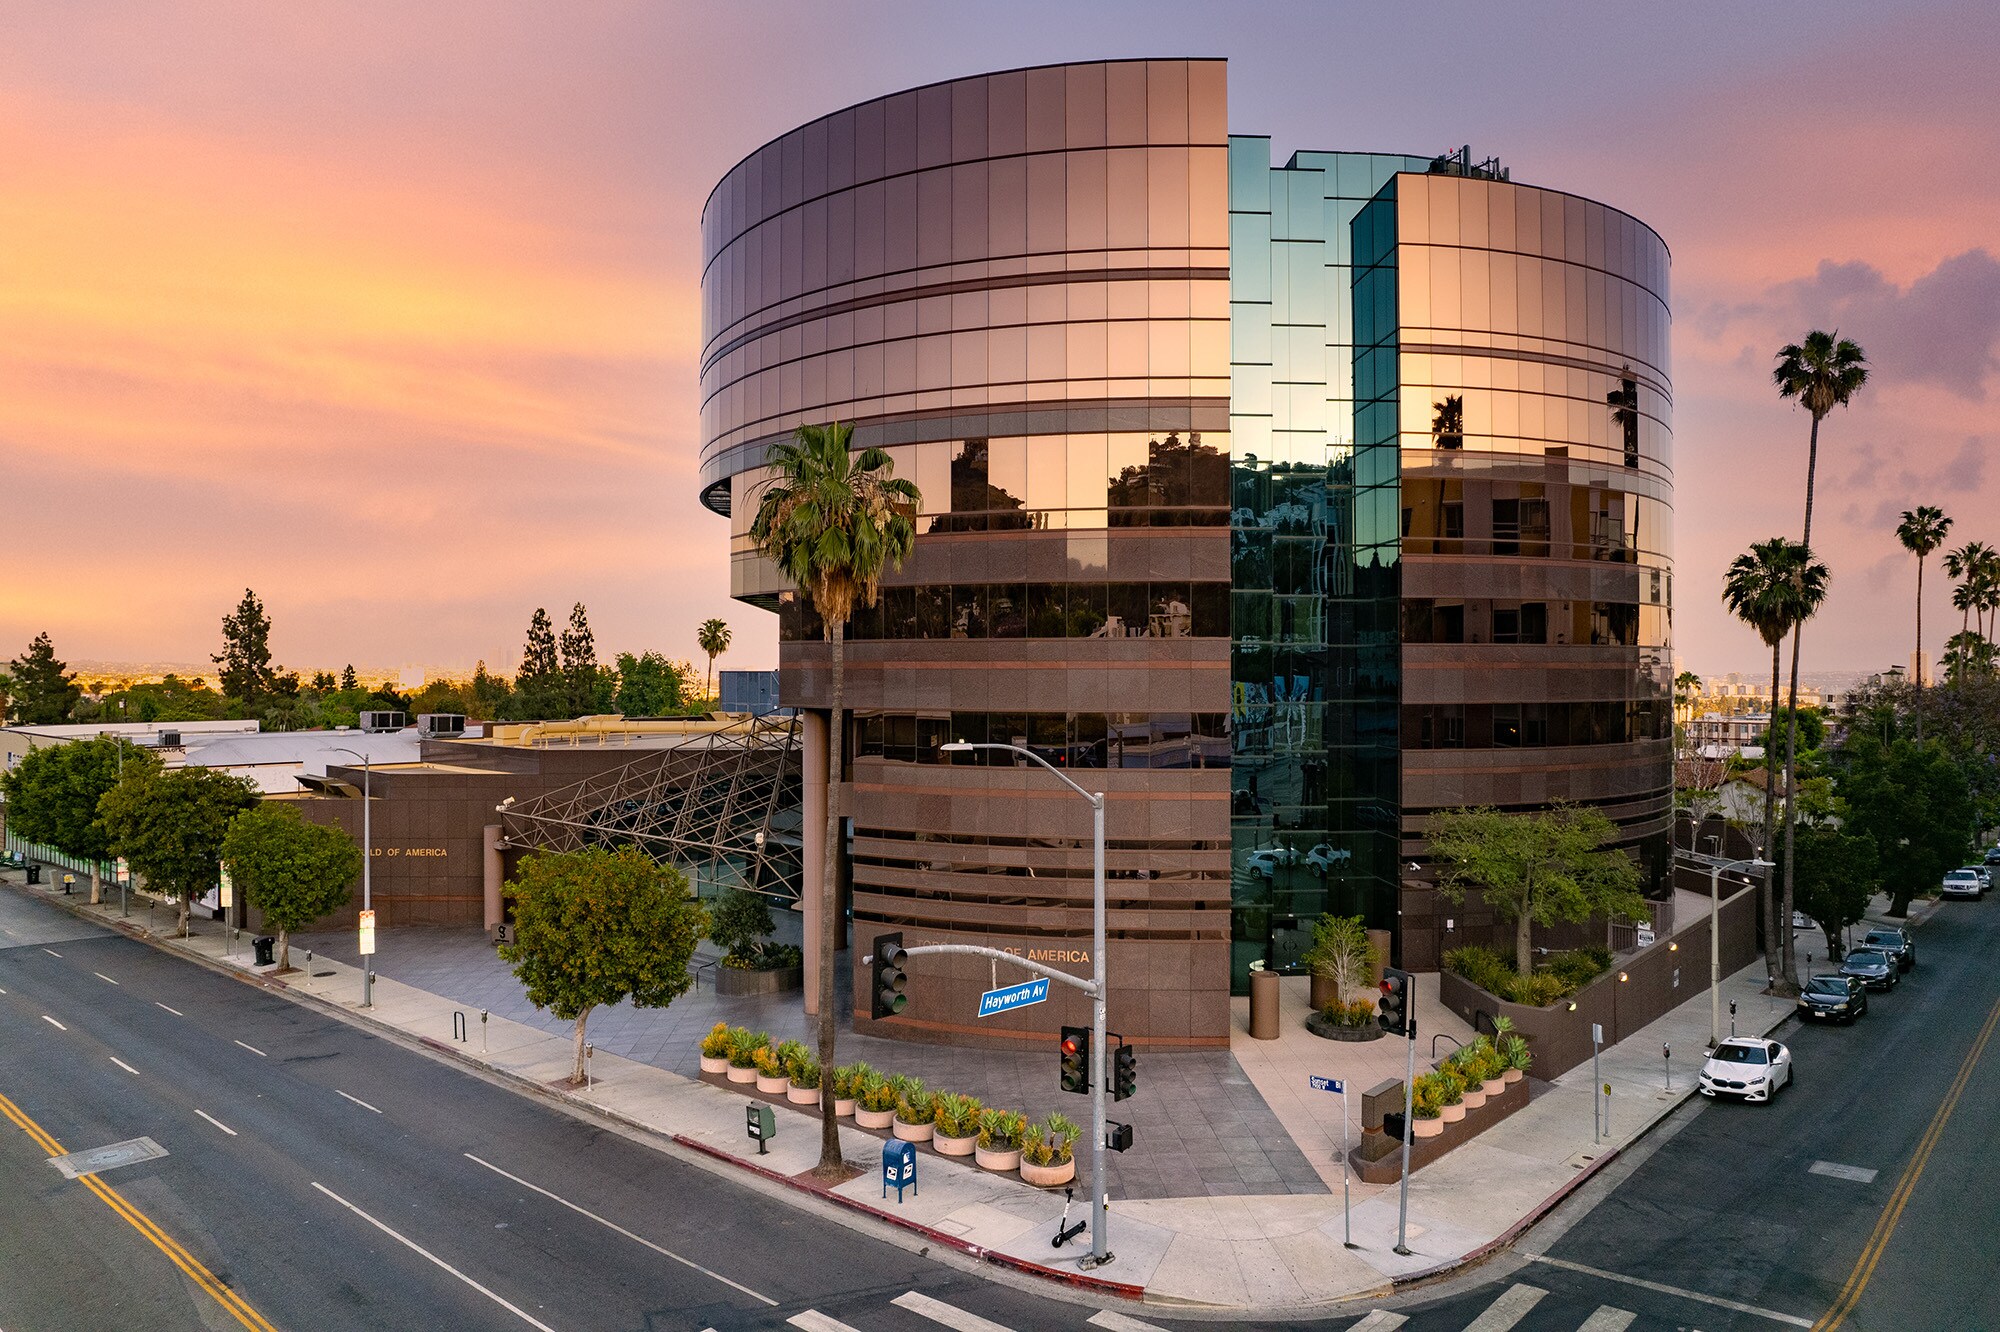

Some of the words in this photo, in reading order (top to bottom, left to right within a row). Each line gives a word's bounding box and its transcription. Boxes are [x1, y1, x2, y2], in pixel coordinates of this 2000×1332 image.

[387, 848, 400, 857] OF
[405, 848, 448, 857] AMERICA
[1028, 949, 1090, 963] AMERICA
[984, 987, 1031, 1010] Hayworth
[1032, 984, 1045, 998] Av
[1311, 1076, 1329, 1087] Sunset
